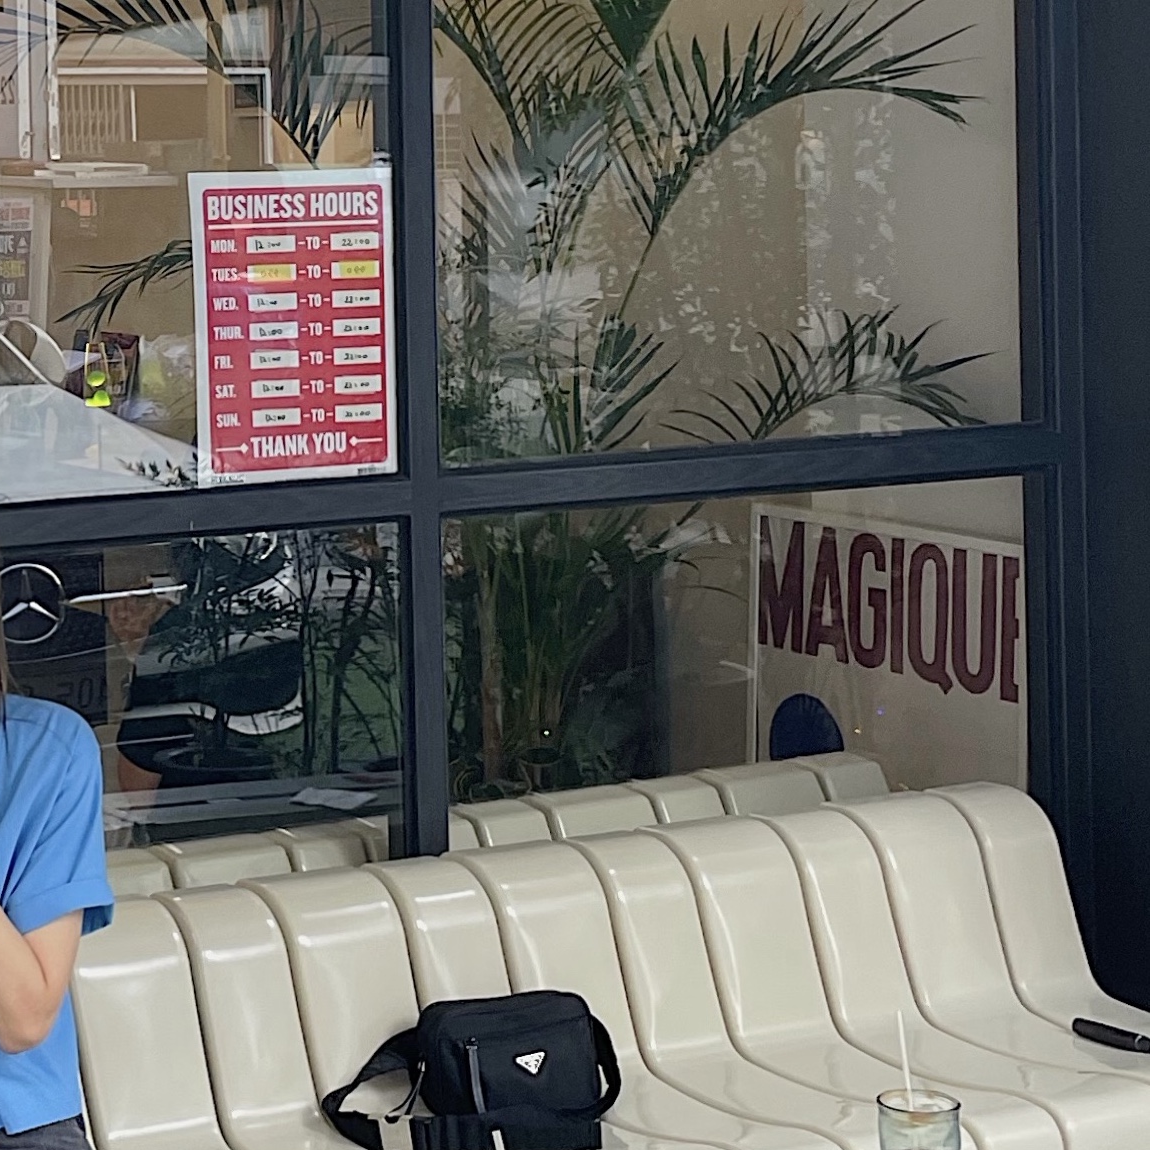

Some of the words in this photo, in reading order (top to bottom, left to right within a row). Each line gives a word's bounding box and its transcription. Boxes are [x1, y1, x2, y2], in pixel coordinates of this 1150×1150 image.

[207, 192, 306, 221] BUSINESS
[310, 190, 379, 217] HOURS
[210, 239, 237, 254] MON.
[211, 267, 241, 282] TUES.
[212, 296, 239, 312] WED.
[213, 325, 244, 341] THUR.
[214, 354, 234, 370] FRI.
[215, 383, 237, 399] SAT.
[216, 412, 241, 428] SUN.
[250, 432, 310, 458] THANK
[312, 430, 347, 455] YOU
[757, 515, 1020, 704] MAGIQUE
